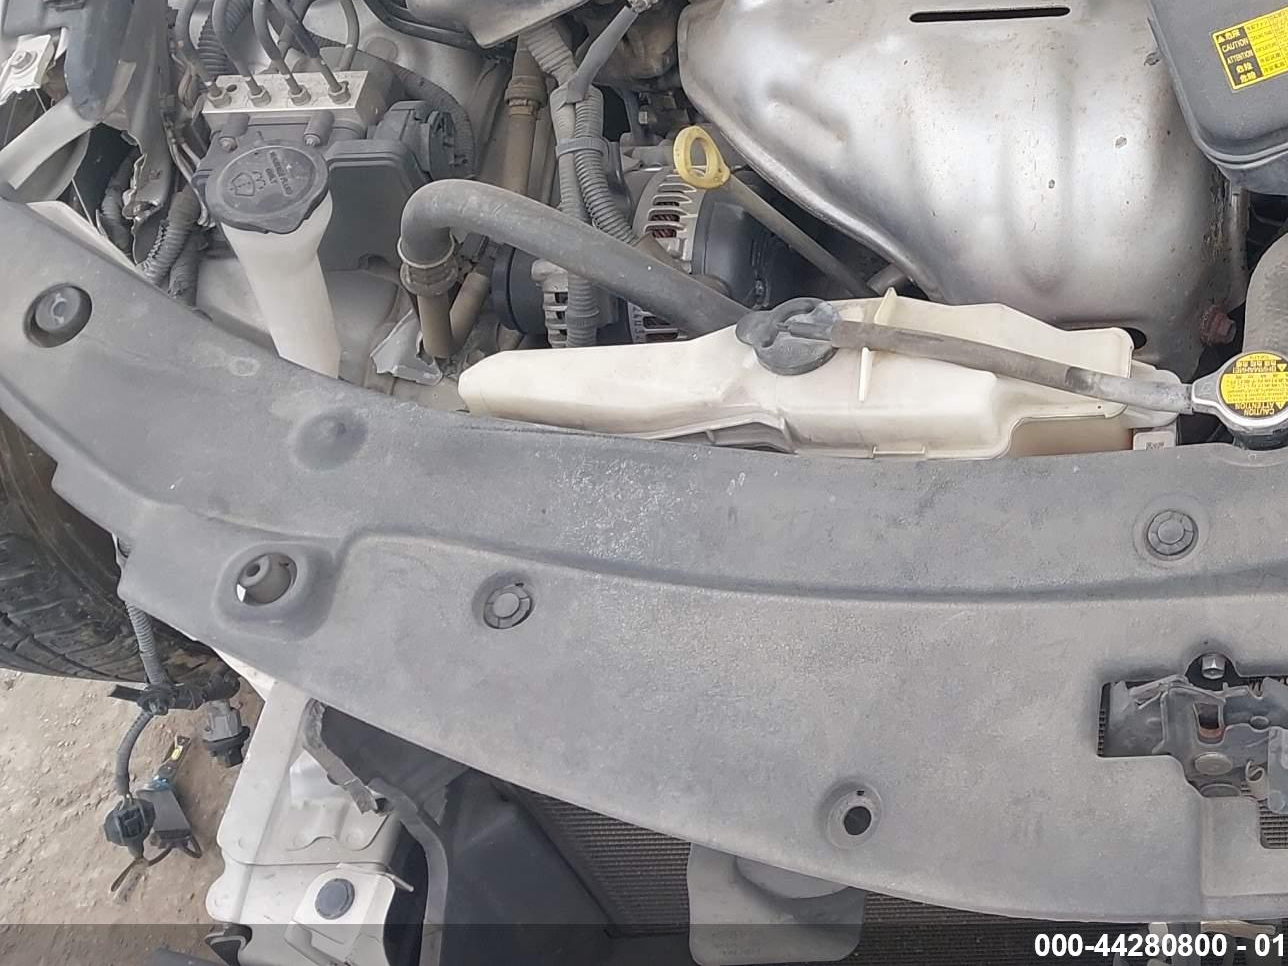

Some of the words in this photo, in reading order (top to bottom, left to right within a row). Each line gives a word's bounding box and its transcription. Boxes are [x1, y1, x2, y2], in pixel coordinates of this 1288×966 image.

[1221, 37, 1249, 53] CAUTION
[1226, 49, 1254, 64] ATTENTION
[1244, 408, 1274, 416] CAUTION
